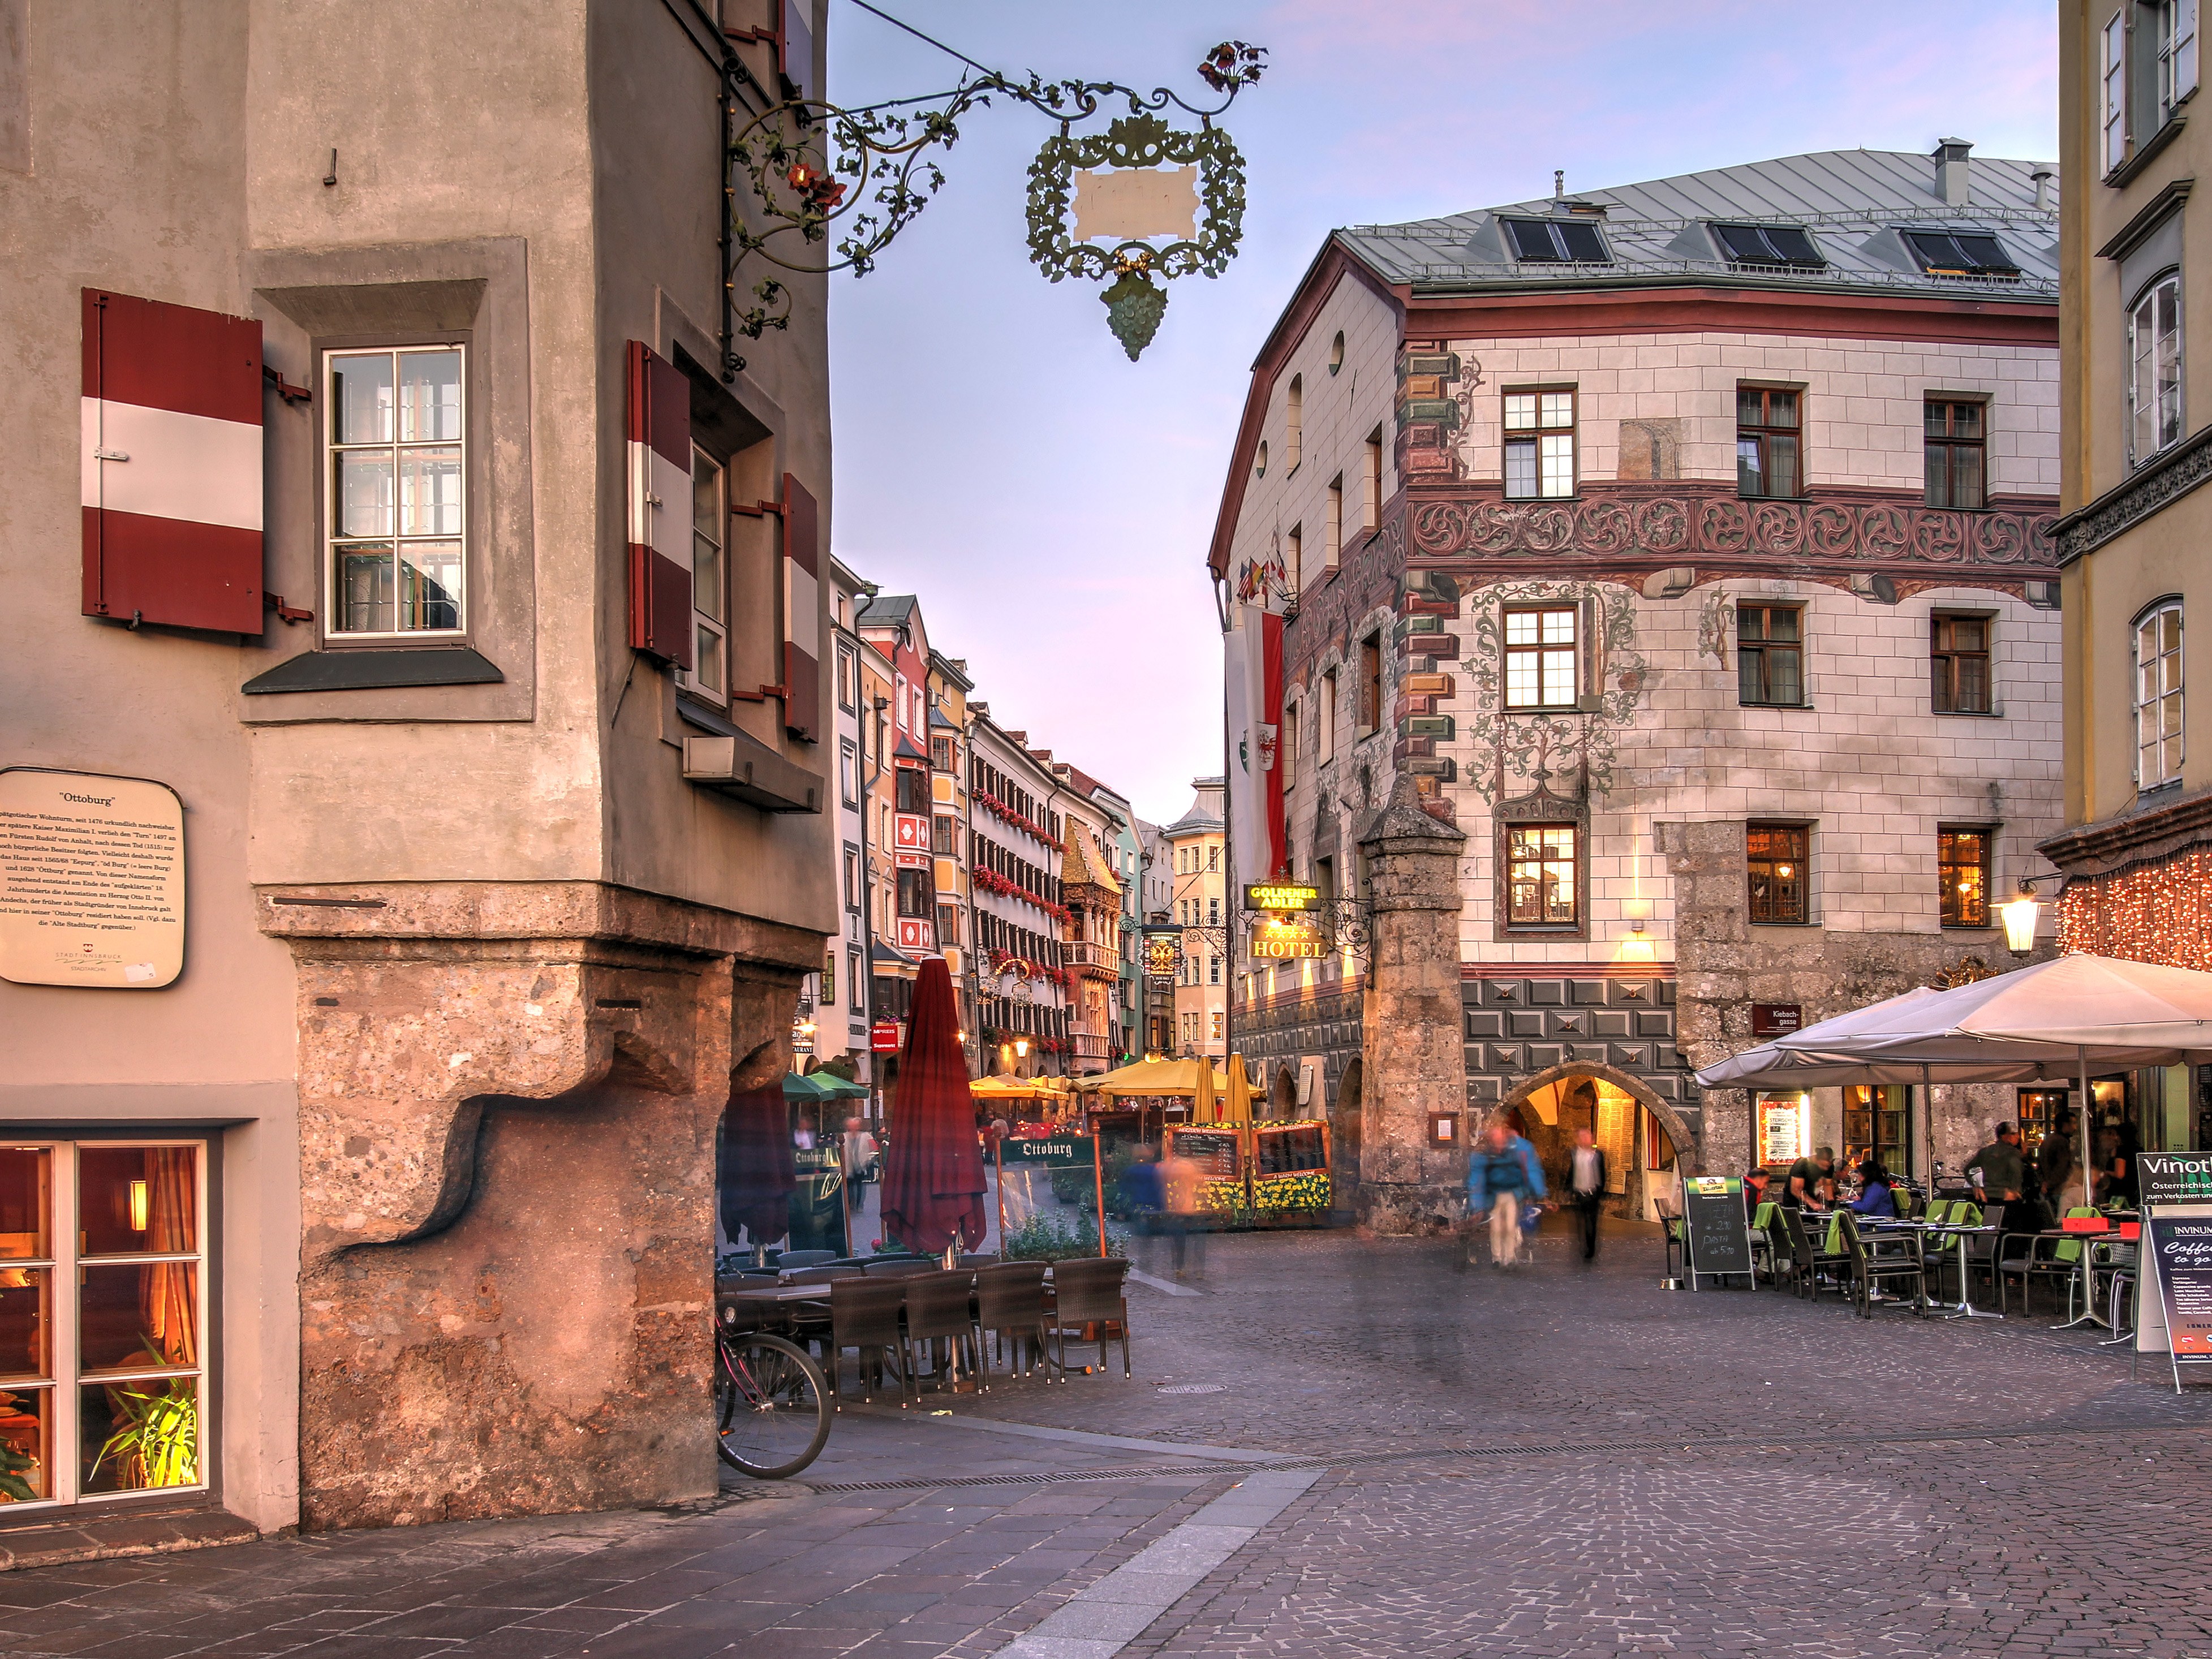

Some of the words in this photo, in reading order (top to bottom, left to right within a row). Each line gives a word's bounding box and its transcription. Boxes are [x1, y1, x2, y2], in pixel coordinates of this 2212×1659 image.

[59, 792, 115, 807] "Ottoburg"
[39, 814, 74, 822] Wohnturm,
[1250, 887, 1318, 899] GOLDENER
[1260, 897, 1305, 909] ADLER
[1253, 941, 1327, 958] HOTEL
[1023, 1141, 1073, 1158] Ottoburg
[796, 1152, 827, 1165] Ottoburg
[2143, 1156, 2212, 1174] Vinot
[1701, 1235, 1728, 1250] PASTA
[2194, 1256, 2211, 1265] go
